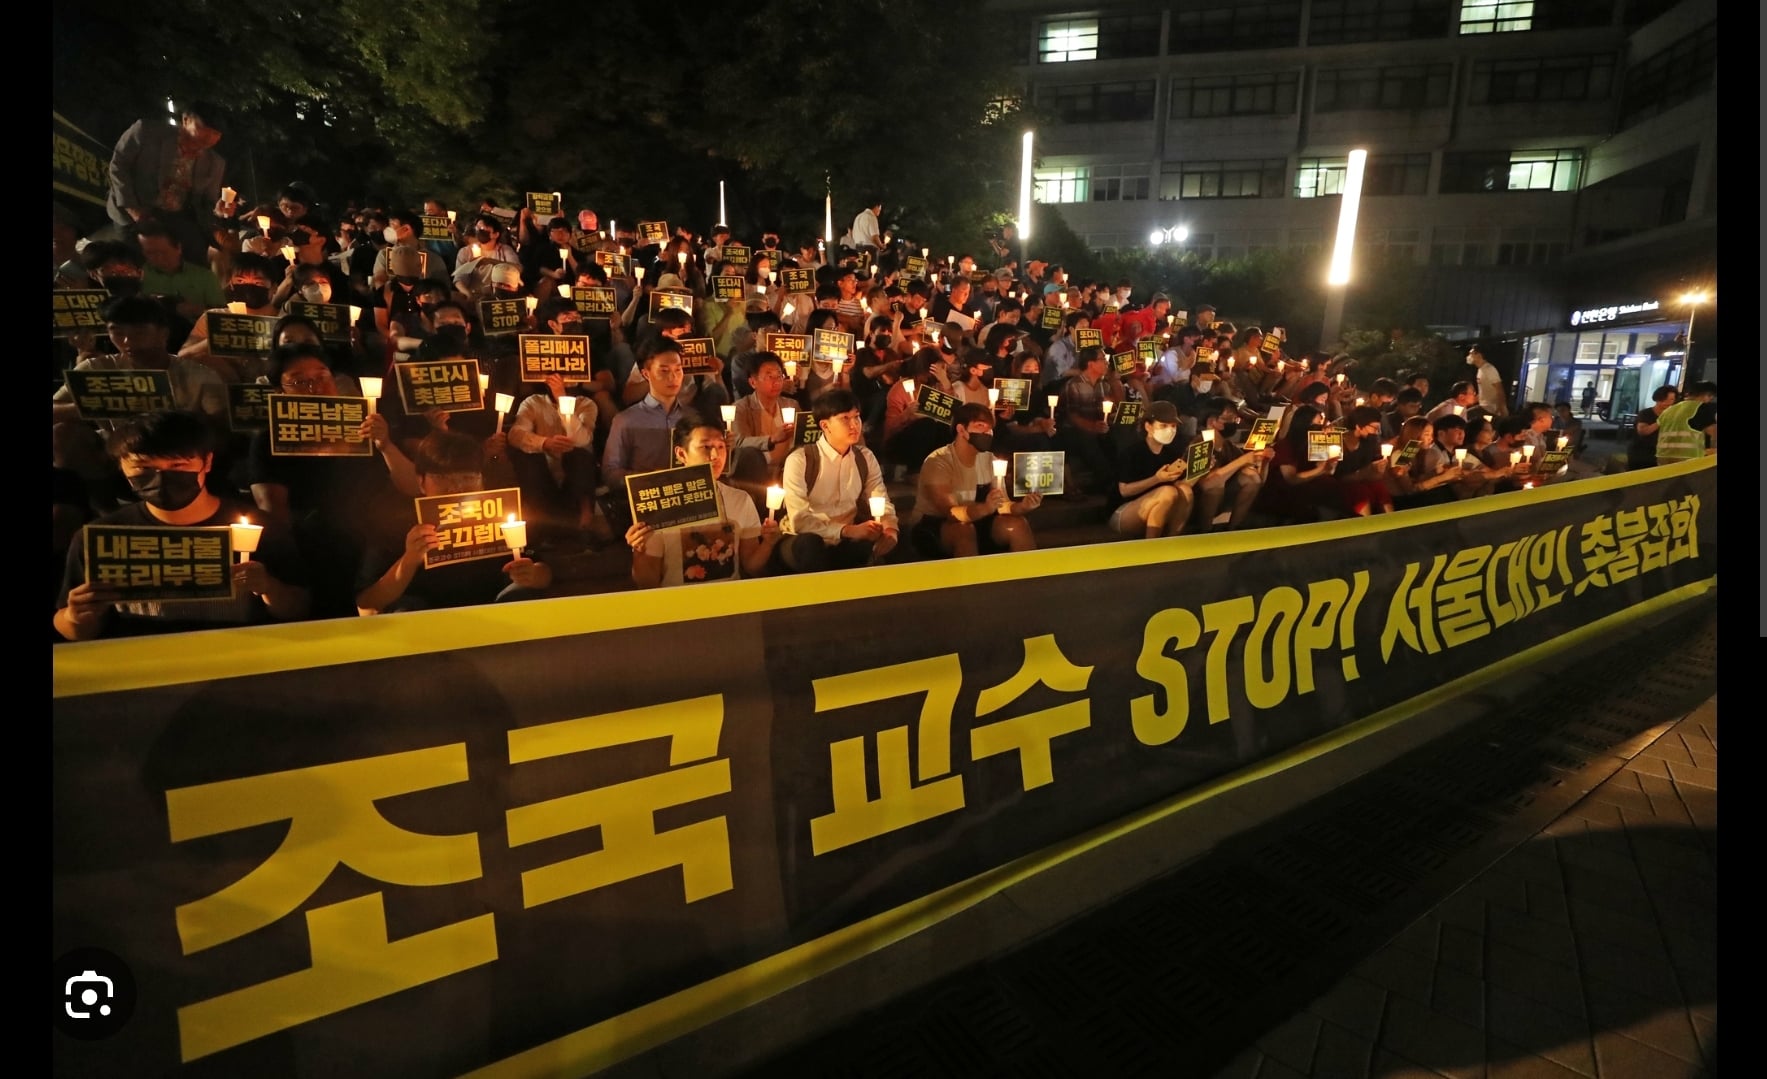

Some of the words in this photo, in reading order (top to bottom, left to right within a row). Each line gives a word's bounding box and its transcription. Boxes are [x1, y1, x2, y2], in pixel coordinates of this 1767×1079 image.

[790, 281, 810, 290] STOP
[490, 302, 504, 315] 조
[505, 301, 518, 314] 국
[1581, 306, 1618, 324] 신한은행
[220, 318, 271, 335] 조국이
[312, 320, 339, 334] TOP
[492, 315, 520, 329] STOP
[681, 343, 707, 356] 국이
[774, 337, 805, 350] 조국이
[525, 356, 586, 373] 물러나라
[409, 363, 469, 385] 또다시
[84, 376, 157, 394] 조국이
[413, 384, 472, 405] 촛불을
[927, 390, 941, 402] 조
[942, 395, 955, 409] 국
[276, 401, 364, 422] 내로남불
[924, 401, 952, 419] STOP
[806, 415, 818, 428] 조
[277, 423, 365, 444] 표리부동
[1026, 455, 1039, 471] 조
[1042, 455, 1053, 470] 국
[1192, 457, 1209, 473] STOP
[638, 486, 661, 501] 한번
[686, 478, 708, 492] 말은
[1024, 472, 1054, 489] STOP
[636, 500, 659, 514] 주워
[660, 496, 682, 510] 담지
[683, 489, 714, 505] 못한다
[437, 497, 504, 526] 조국이
[96, 535, 223, 560] 내로남불
[97, 563, 224, 587] 표리부동
[165, 693, 734, 1064] 조국
[810, 633, 1095, 857] 교수
[1130, 570, 1370, 746] STOP!
[1381, 525, 1574, 665] 서울대인
[1574, 494, 1700, 597] 촛불집회
